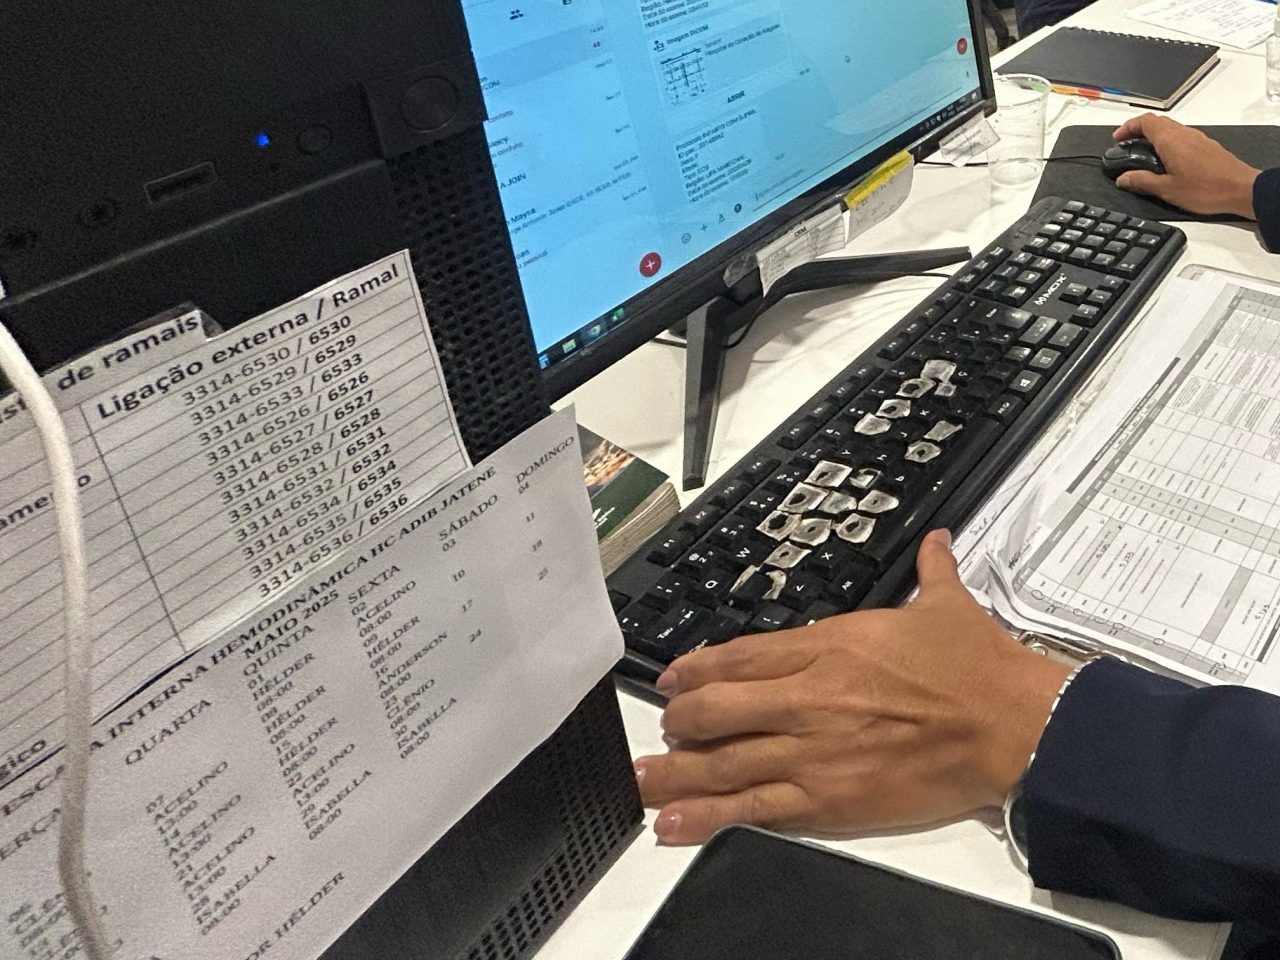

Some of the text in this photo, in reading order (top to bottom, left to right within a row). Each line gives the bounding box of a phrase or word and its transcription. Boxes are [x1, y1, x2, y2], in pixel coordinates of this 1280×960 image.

[57, 315, 199, 391] de ramais
[98, 263, 399, 419] Ligação externa Ramal
[183, 315, 351, 406] 3314-6530 6530
[191, 334, 356, 425] 3314-6529 6529
[200, 353, 363, 447] 3314-6533 6533
[206, 371, 369, 467] 3314-6526 6526
[213, 390, 375, 486] 3314-6527 6527
[220, 407, 381, 505] 3314-6528 6528
[228, 426, 387, 524] 3314-6531 6531
[235, 443, 392, 542] 3314-6532 6532
[242, 460, 397, 561] 3314-6534 6534
[250, 477, 402, 579] 3314-6535 6535
[258, 494, 408, 598] 3314-6536 6536
[108, 466, 496, 739] INTERNA HEMODINÂMICA HC ADIB JATENE
[125, 436, 575, 765] QUARTA QUINTA SEXTA SÁBADO DOMINGO
[244, 590, 339, 660] MAIO 2025
[356, 580, 417, 628] ACELINO
